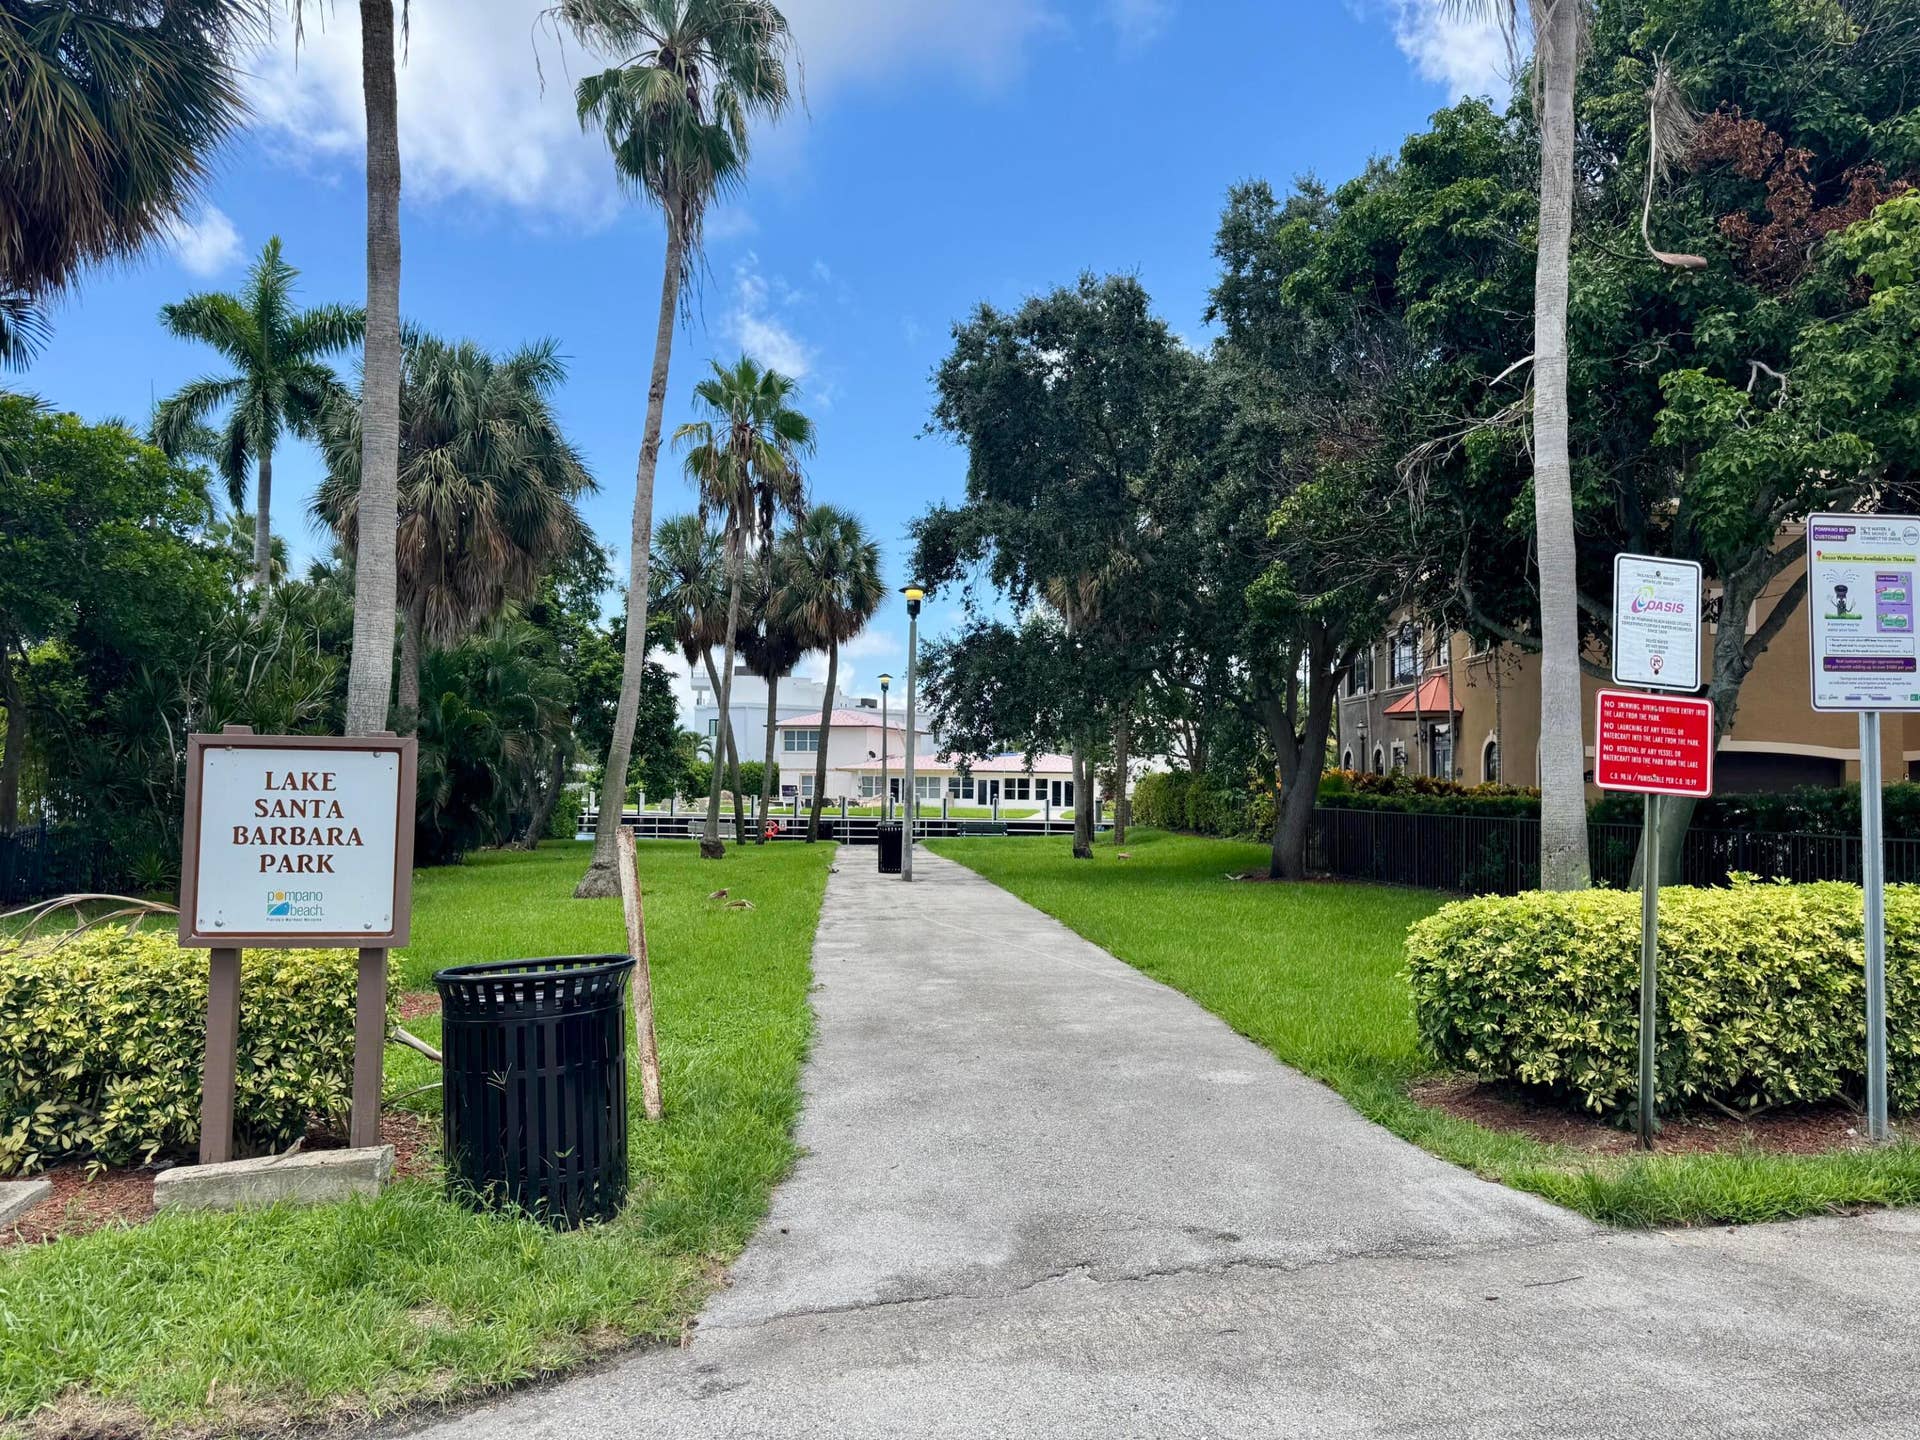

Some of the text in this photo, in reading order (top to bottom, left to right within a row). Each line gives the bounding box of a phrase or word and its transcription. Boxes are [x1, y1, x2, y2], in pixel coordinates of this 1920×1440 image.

[1644, 600, 1684, 613] OASIS
[1617, 723, 1642, 732] LAUNCHING
[1661, 727, 1677, 735] VESSEL
[1604, 732, 1630, 740] WATERCRAFT
[1617, 745, 1639, 754] RETRIEVAL
[1603, 754, 1630, 763] WATERCRAFT
[1678, 760, 1686, 768] THE
[1687, 760, 1699, 768] LAKE
[264, 771, 336, 791] LAKE
[254, 799, 344, 818] SANTA
[232, 826, 364, 846] BARBARA
[258, 854, 335, 873] PARK
[267, 891, 323, 903] pompano
